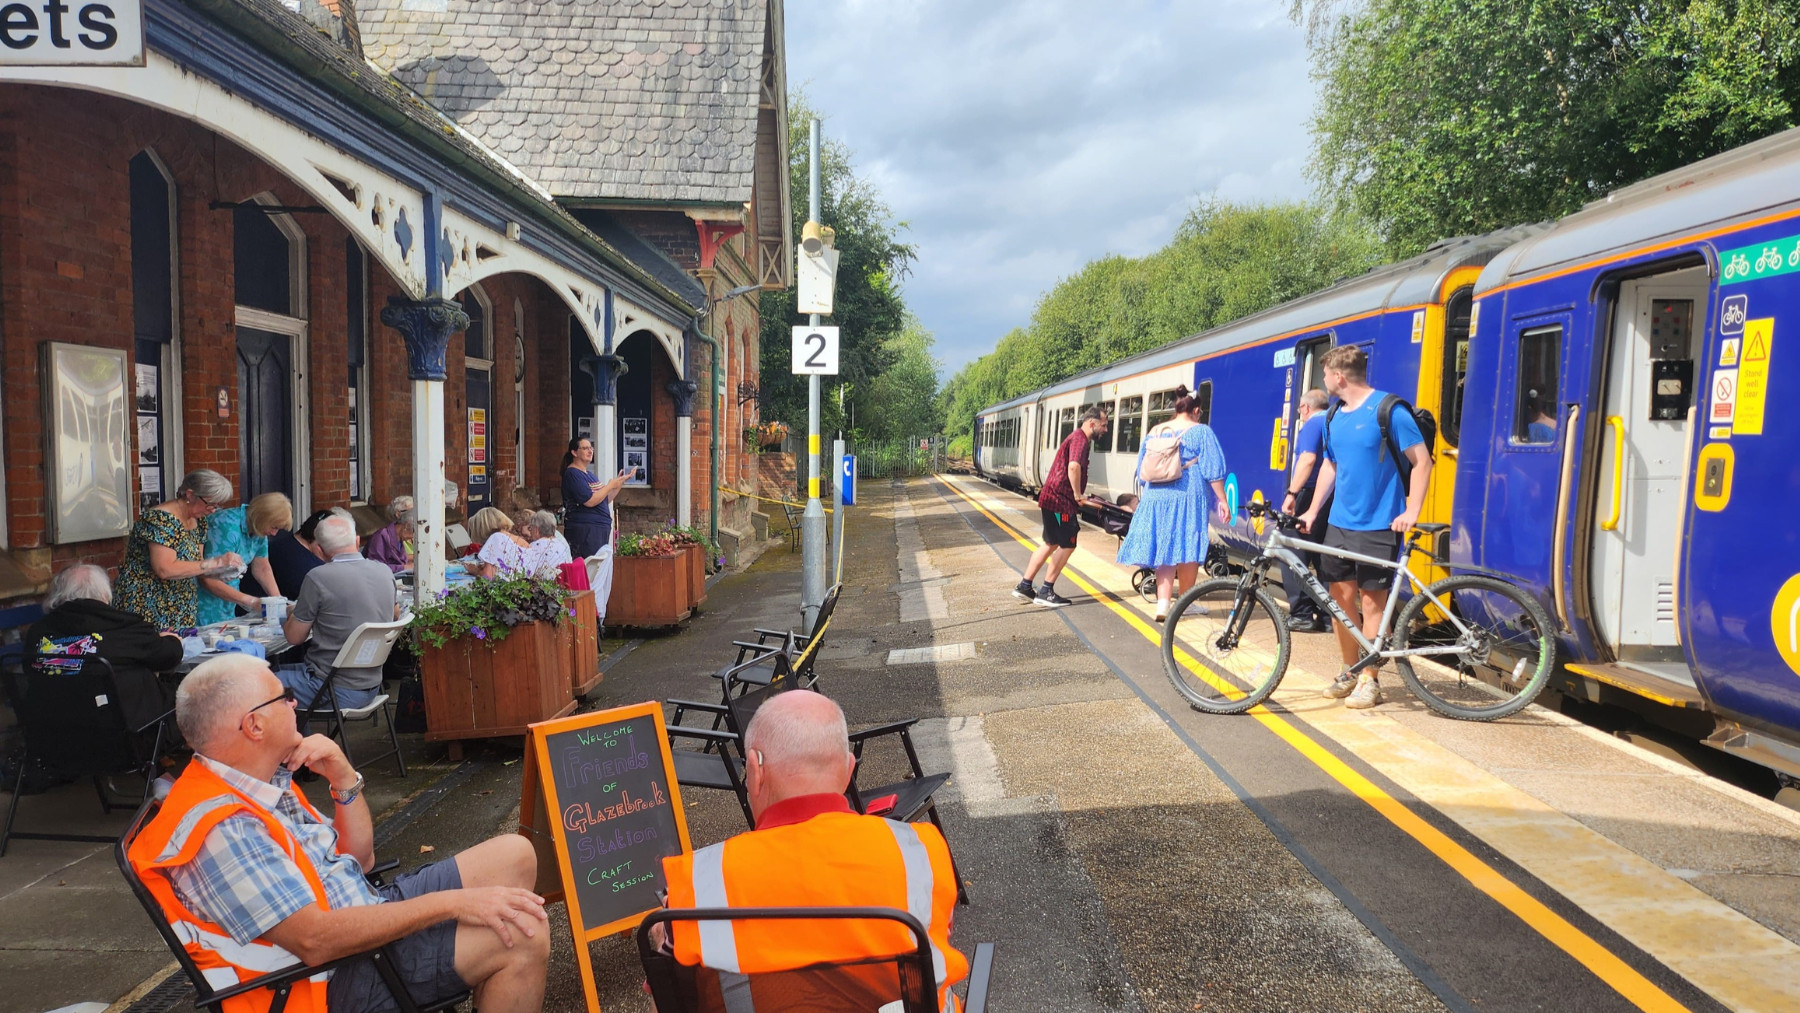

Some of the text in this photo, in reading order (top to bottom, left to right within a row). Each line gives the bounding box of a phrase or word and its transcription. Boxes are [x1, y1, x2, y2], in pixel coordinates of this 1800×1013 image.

[804, 333, 827, 368] 2
[1744, 368, 1763, 378] Stand
[1745, 379, 1759, 388] well
[1743, 389, 1759, 398] clear
[603, 740, 617, 748] TO
[602, 782, 617, 793] OF
[587, 860, 633, 886] CRAFT
